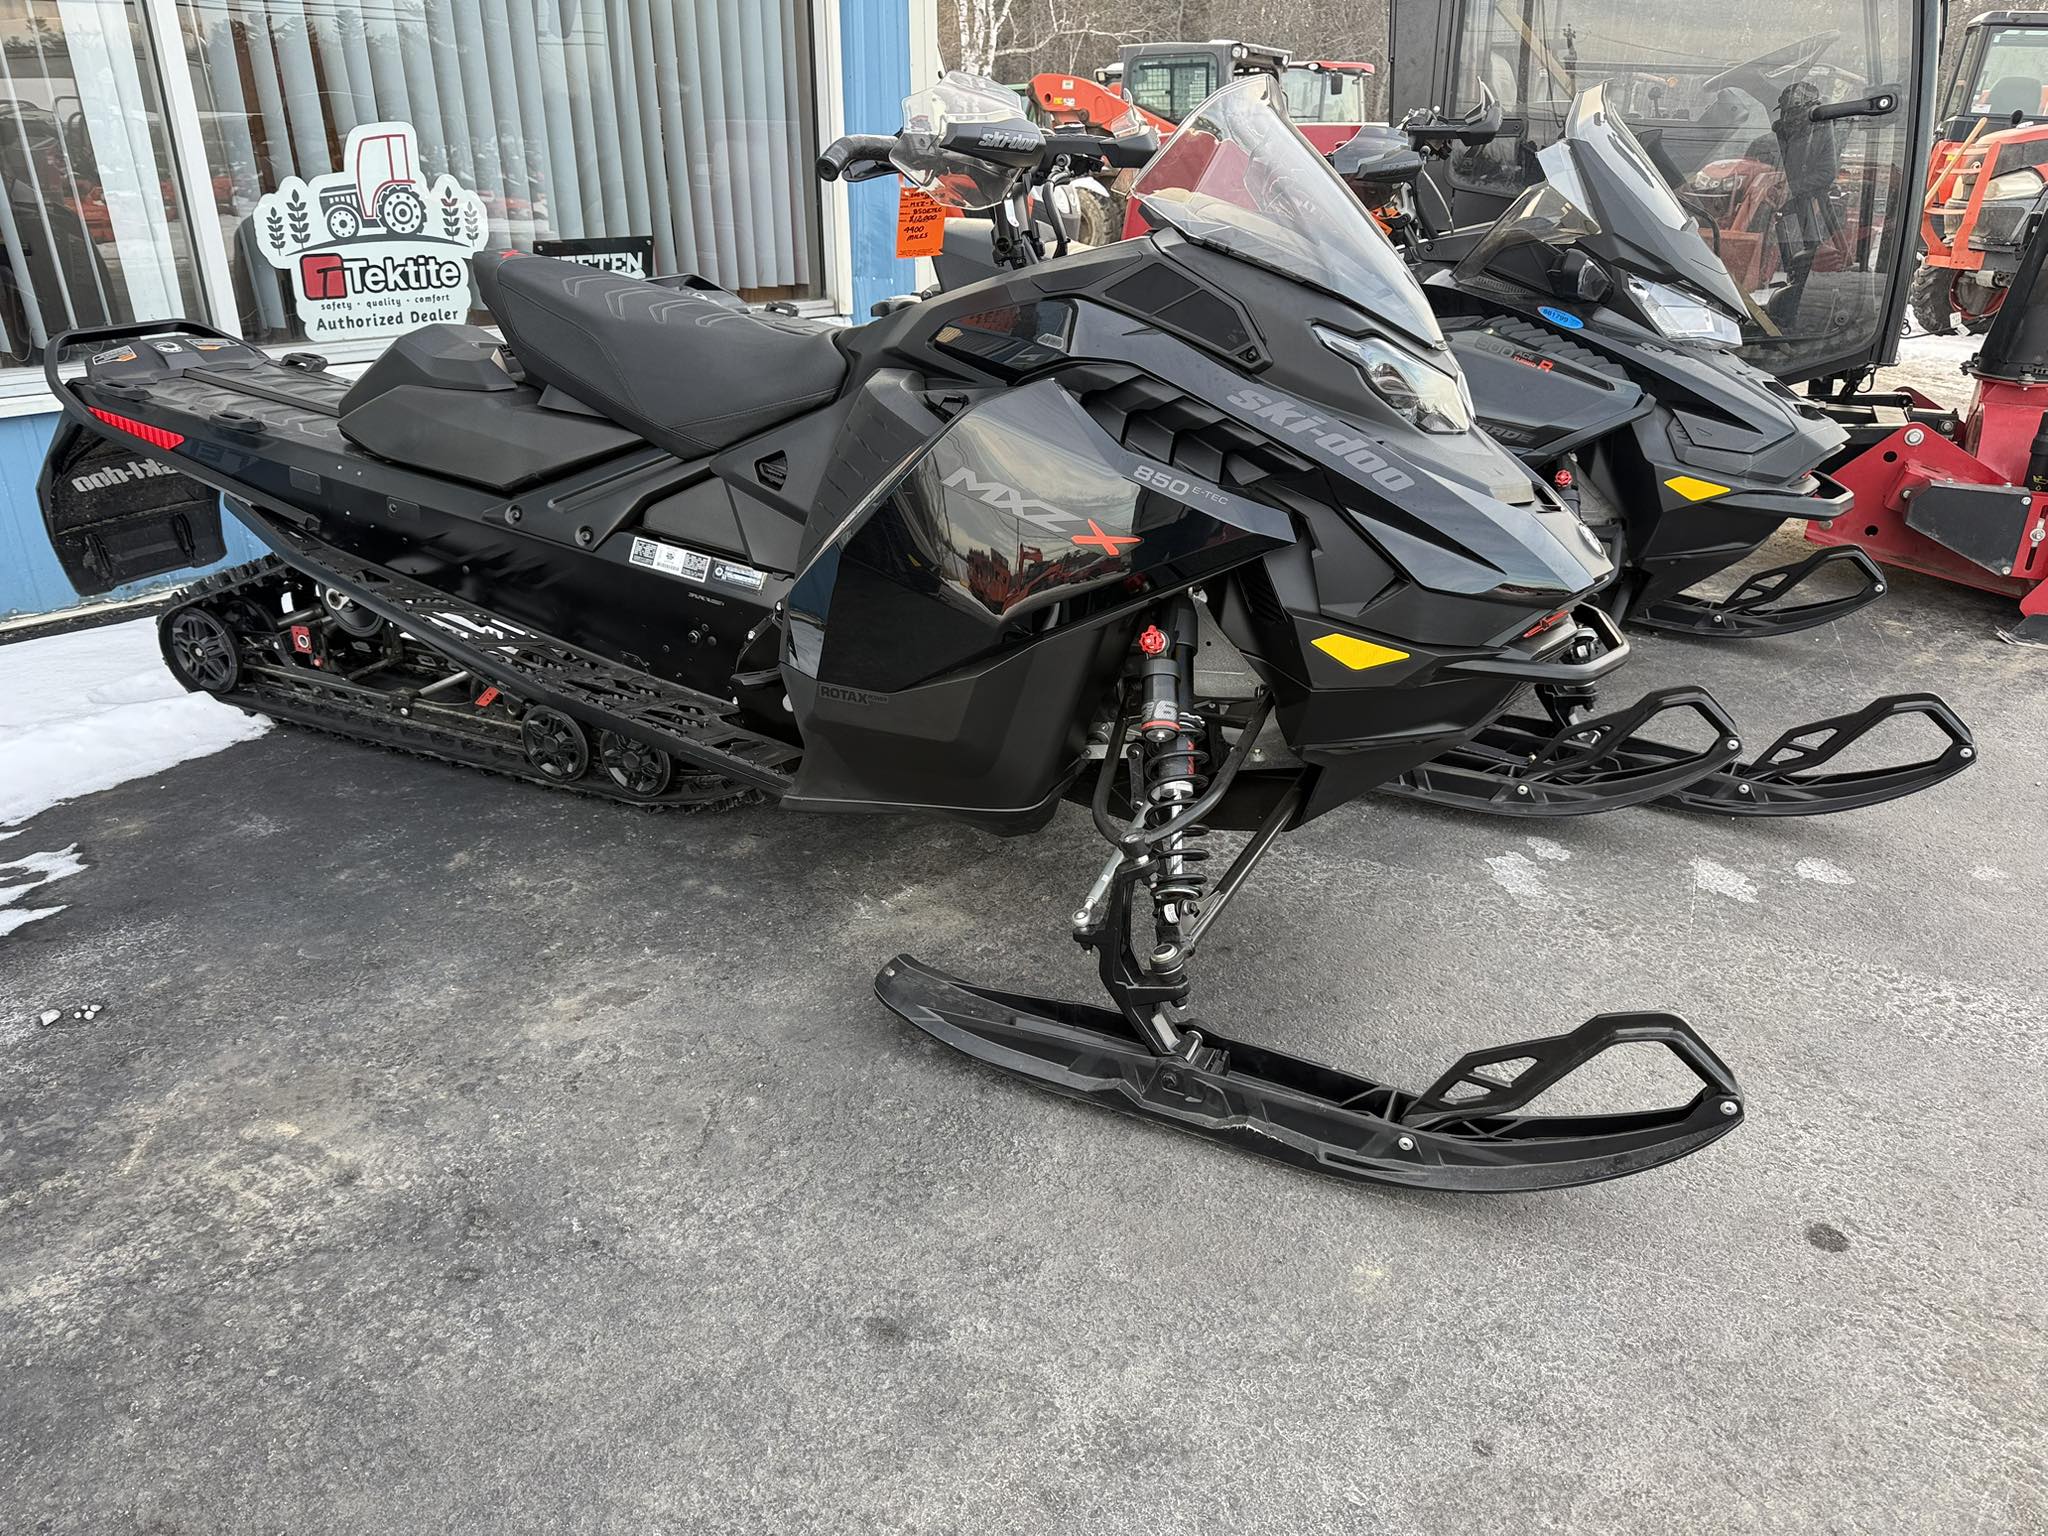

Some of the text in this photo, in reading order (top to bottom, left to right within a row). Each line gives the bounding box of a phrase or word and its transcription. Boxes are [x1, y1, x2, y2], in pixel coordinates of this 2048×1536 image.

[978, 131, 1039, 151] ski-doo
[906, 232, 928, 241] MILES
[344, 255, 461, 294] Tektite
[321, 294, 450, 310] safety quality comfort
[316, 309, 458, 331] Authorized Dealer
[1226, 389, 1415, 492] ski-doo
[1133, 464, 1229, 505] 850 E-TEC
[940, 466, 1085, 533] MXZ
[821, 685, 868, 704] ROTAX
